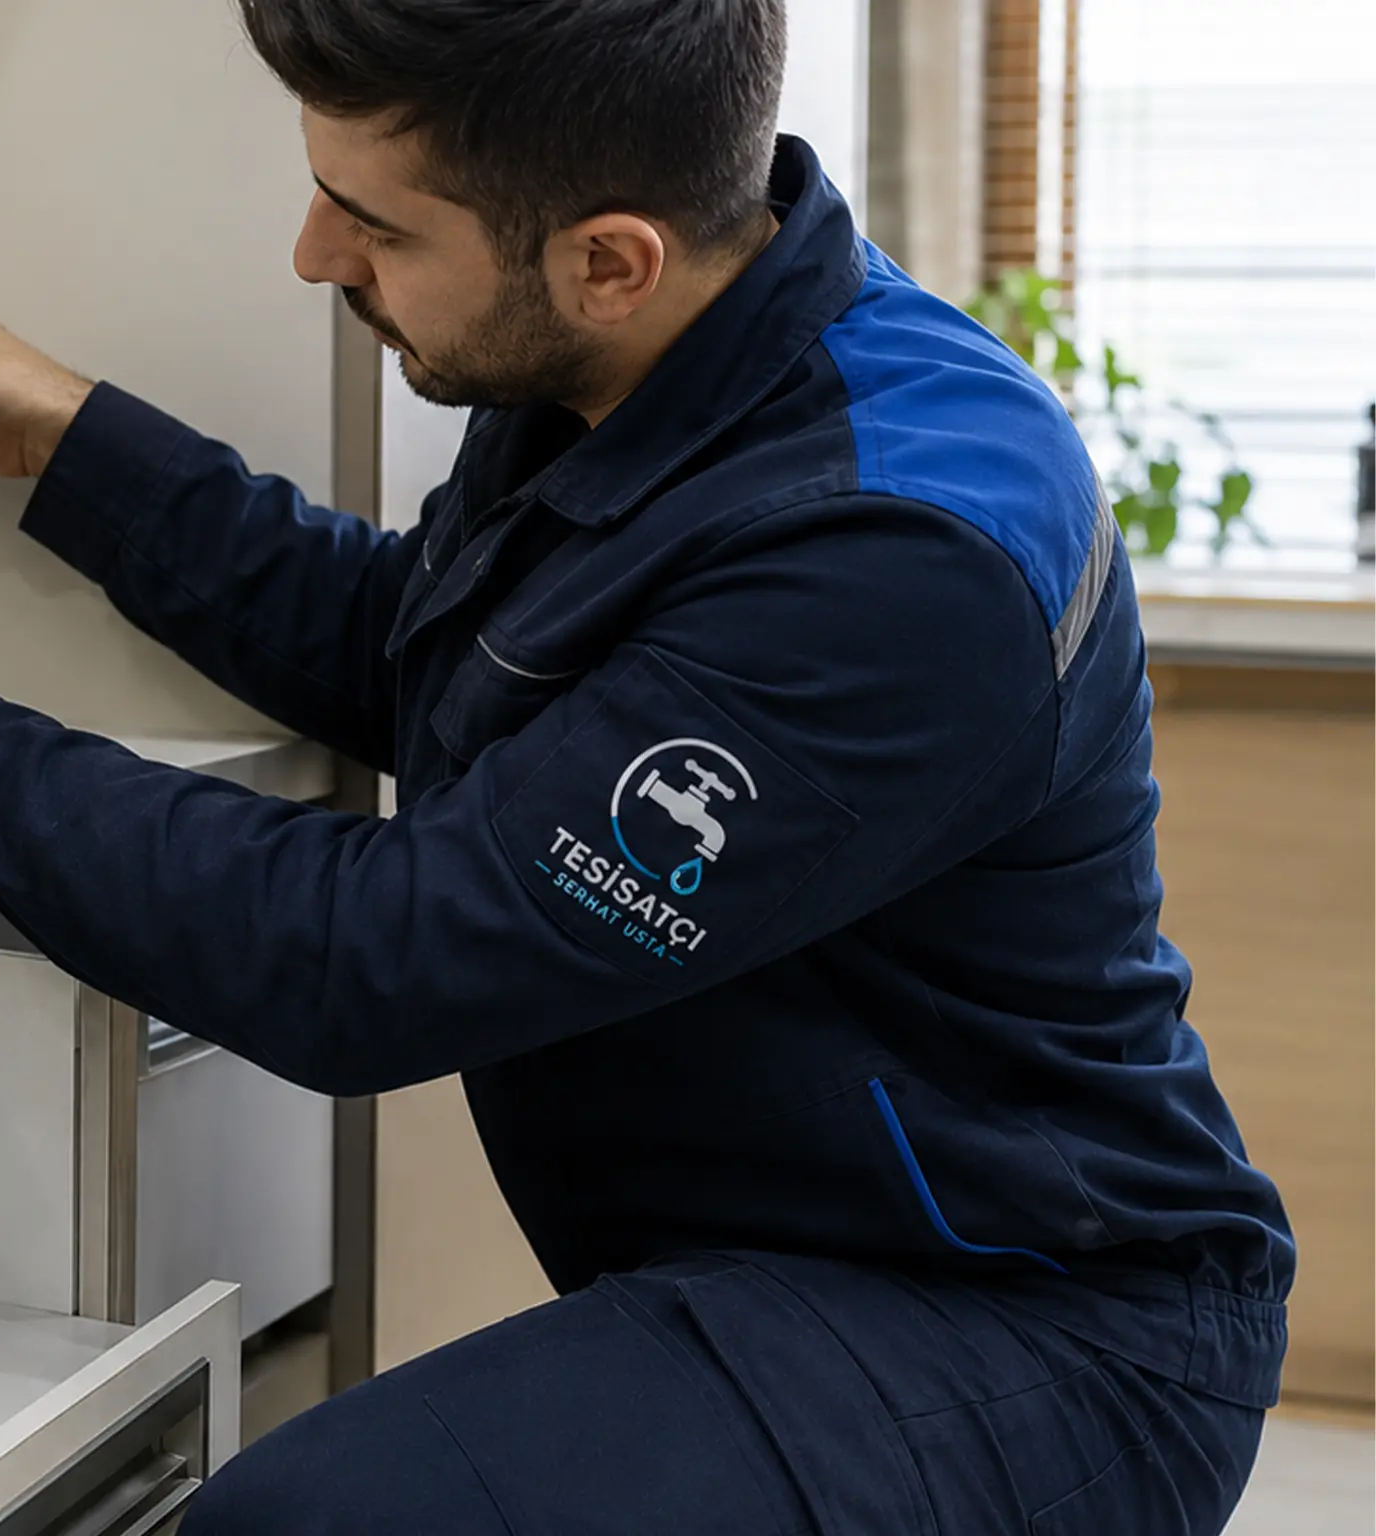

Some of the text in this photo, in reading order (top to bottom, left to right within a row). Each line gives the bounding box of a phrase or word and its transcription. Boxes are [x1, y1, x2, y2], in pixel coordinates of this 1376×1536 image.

[549, 826, 707, 951] TESİSATÇI
[553, 872, 666, 958] SERHAT USTA
